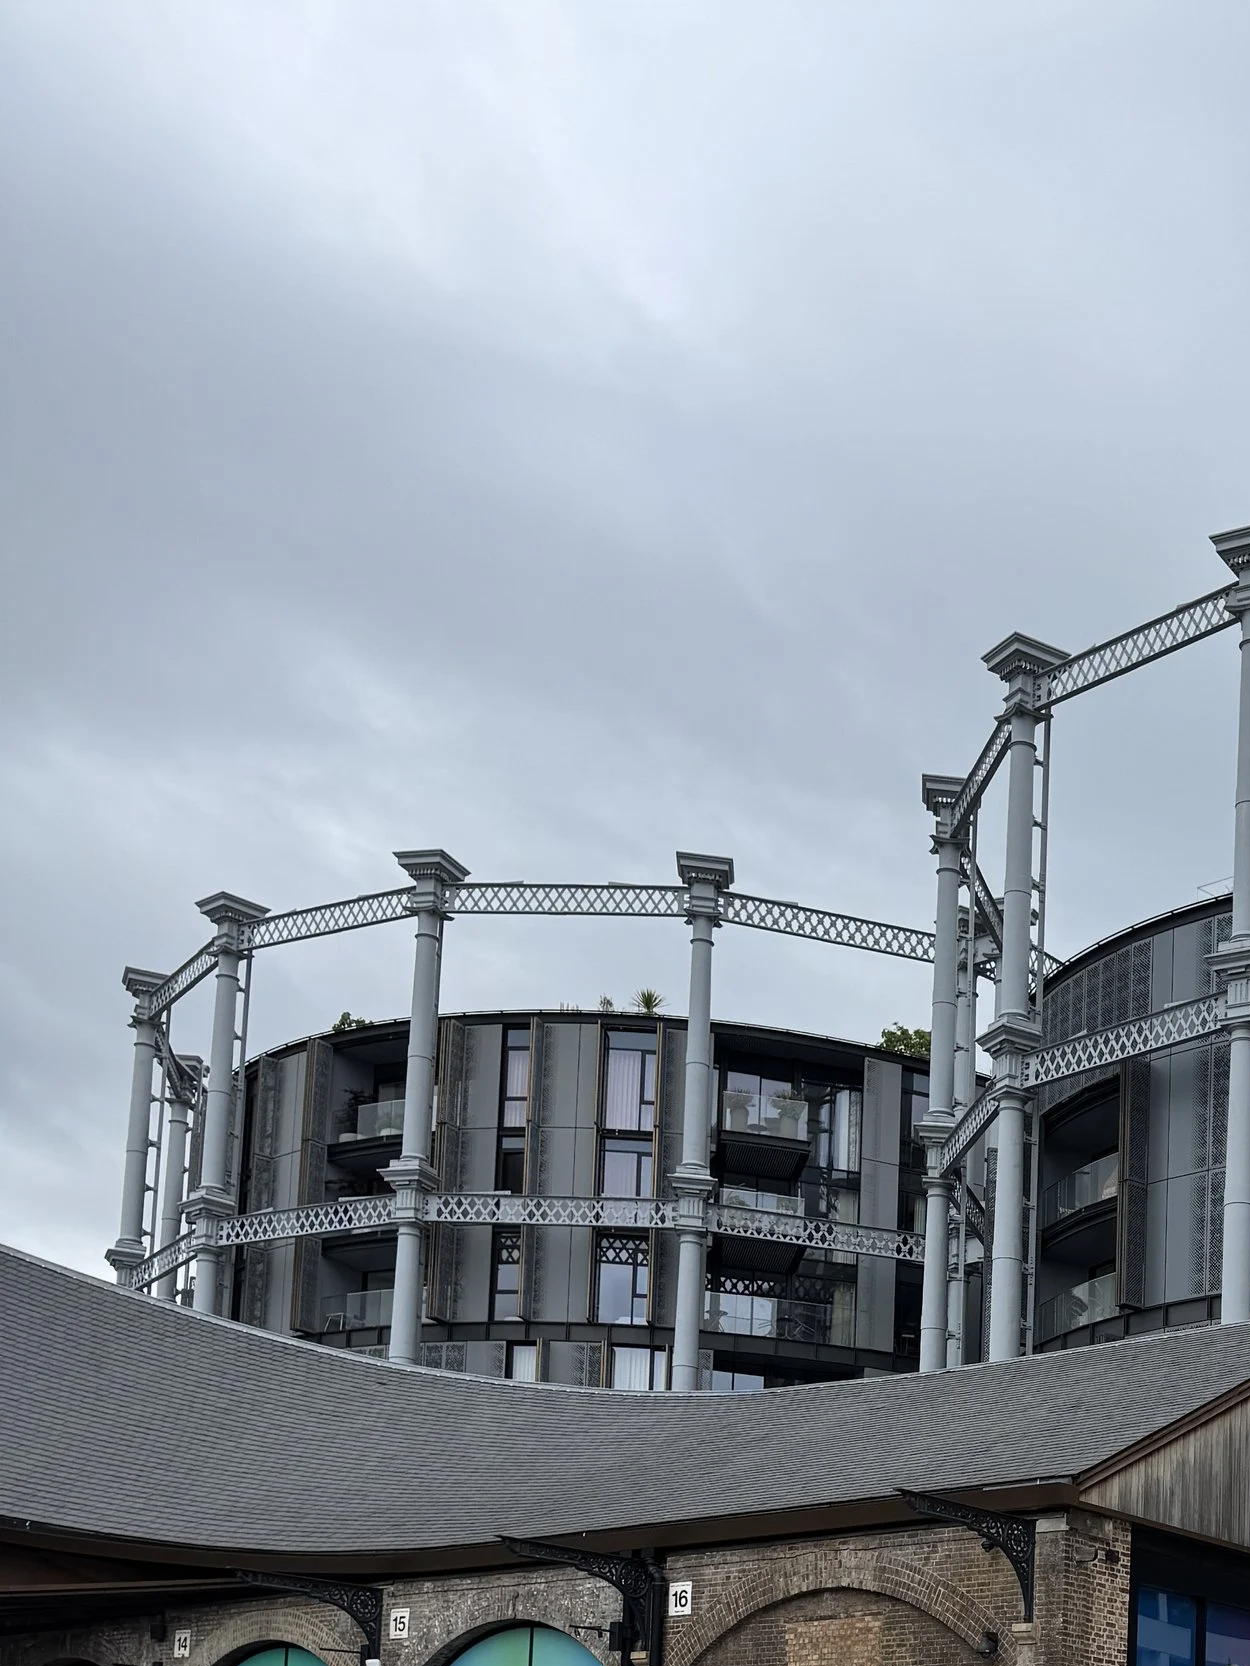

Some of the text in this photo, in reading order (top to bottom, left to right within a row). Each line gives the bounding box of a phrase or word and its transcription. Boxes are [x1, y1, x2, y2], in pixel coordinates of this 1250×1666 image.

[672, 1590, 688, 1607] 16
[393, 1616, 406, 1632] 15
[177, 1636, 188, 1651] 14
